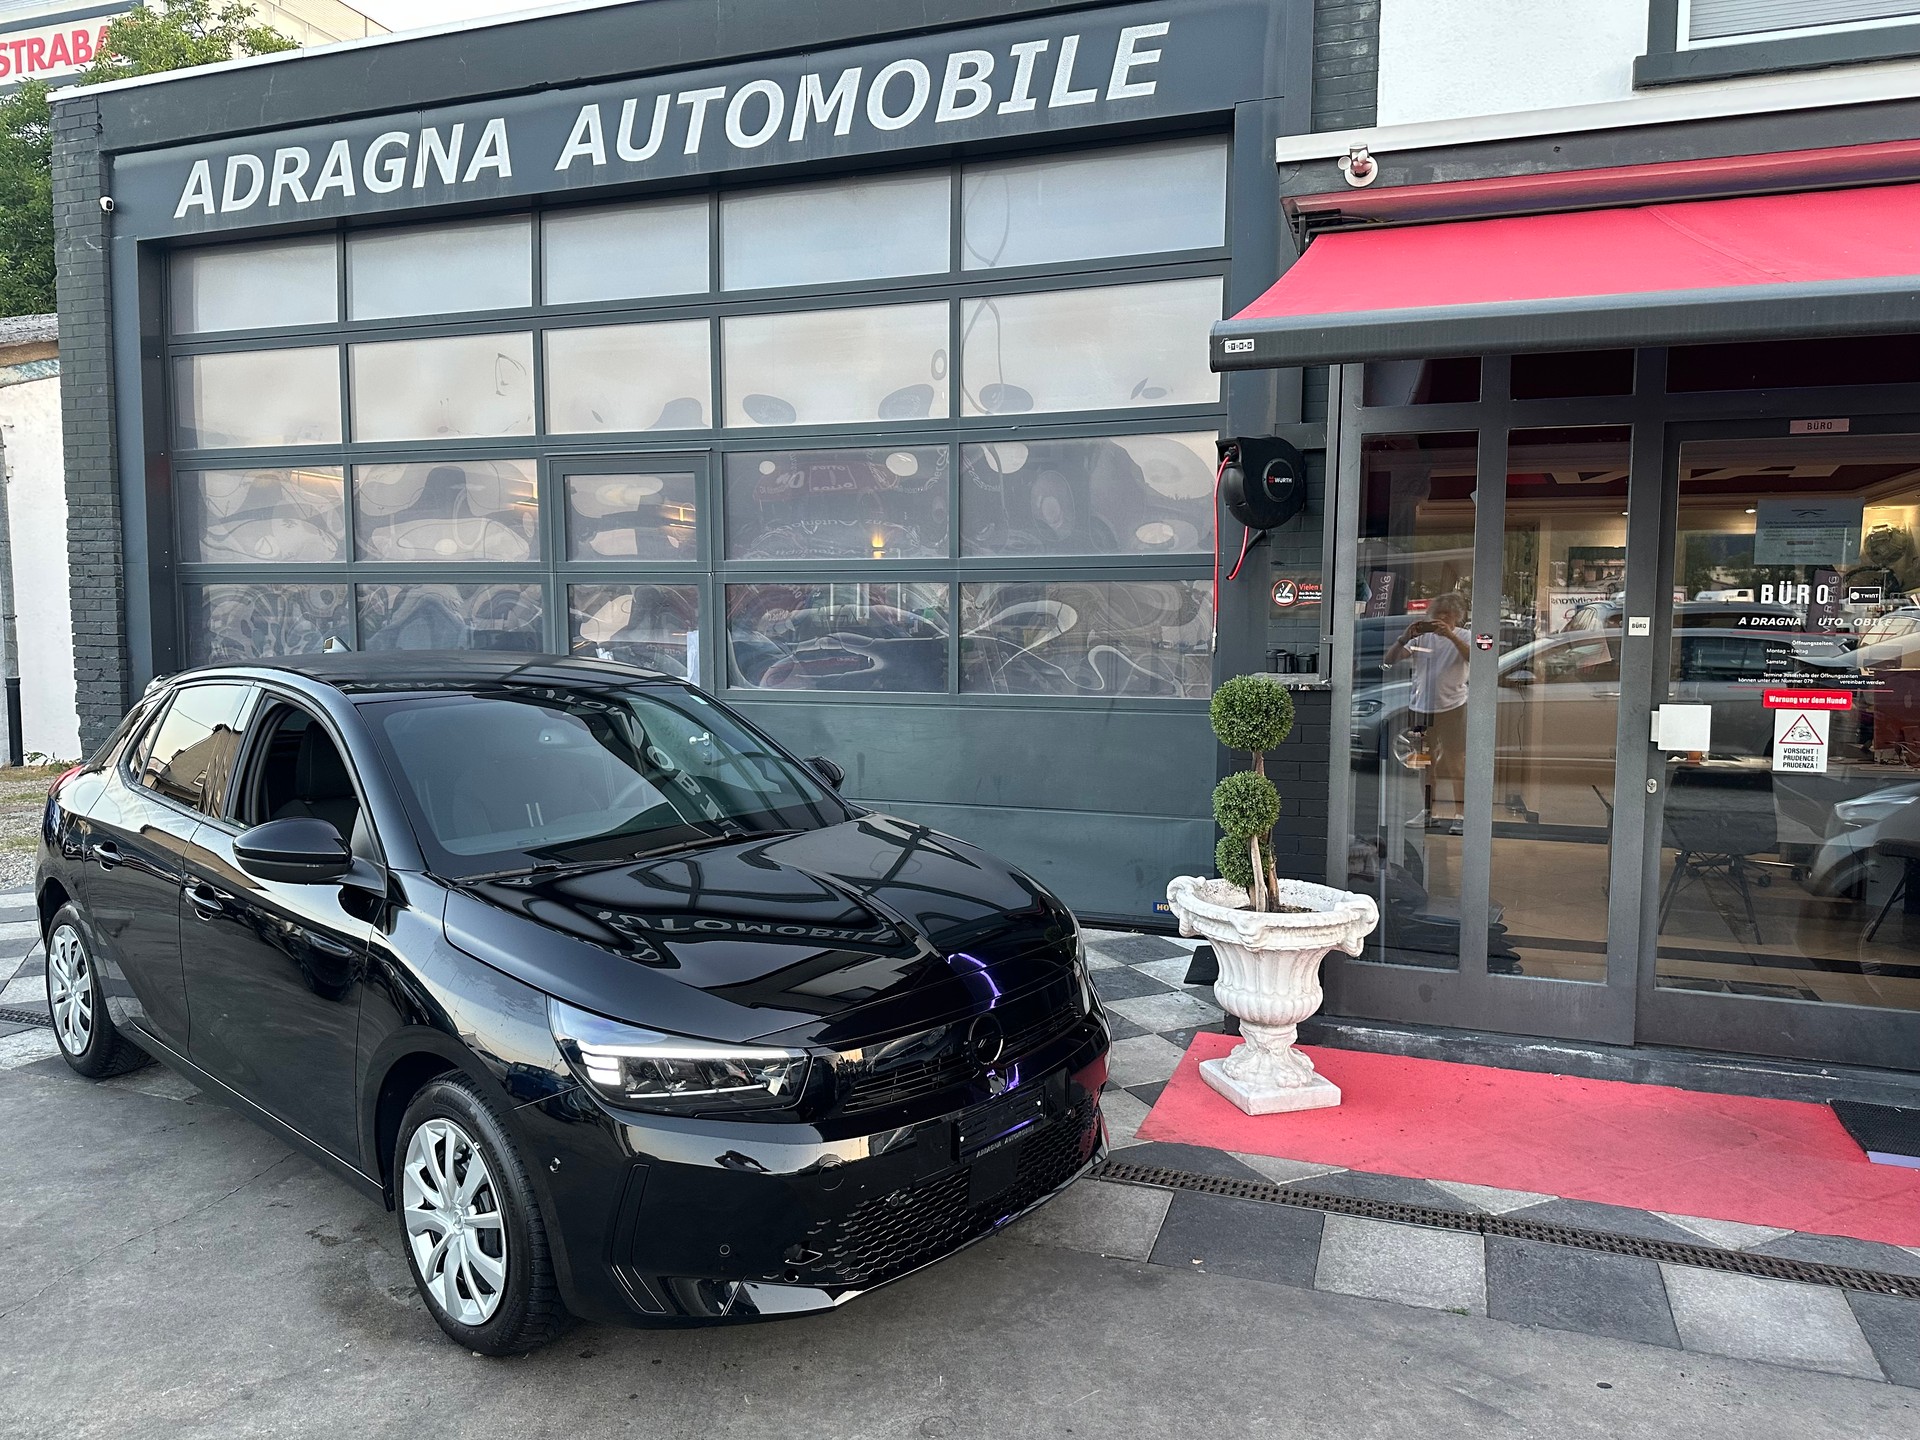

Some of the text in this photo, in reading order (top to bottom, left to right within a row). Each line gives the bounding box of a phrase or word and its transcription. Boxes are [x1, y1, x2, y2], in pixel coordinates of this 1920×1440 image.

[172, 21, 1170, 219] ADRAGNA AUTOMOBILE
[1807, 421, 1832, 430] BÜRO
[1760, 581, 1828, 604] BÜRO
[1750, 617, 1802, 626] DRAGNA
[1769, 696, 1798, 704] Warnung
[1811, 696, 1825, 704] dem
